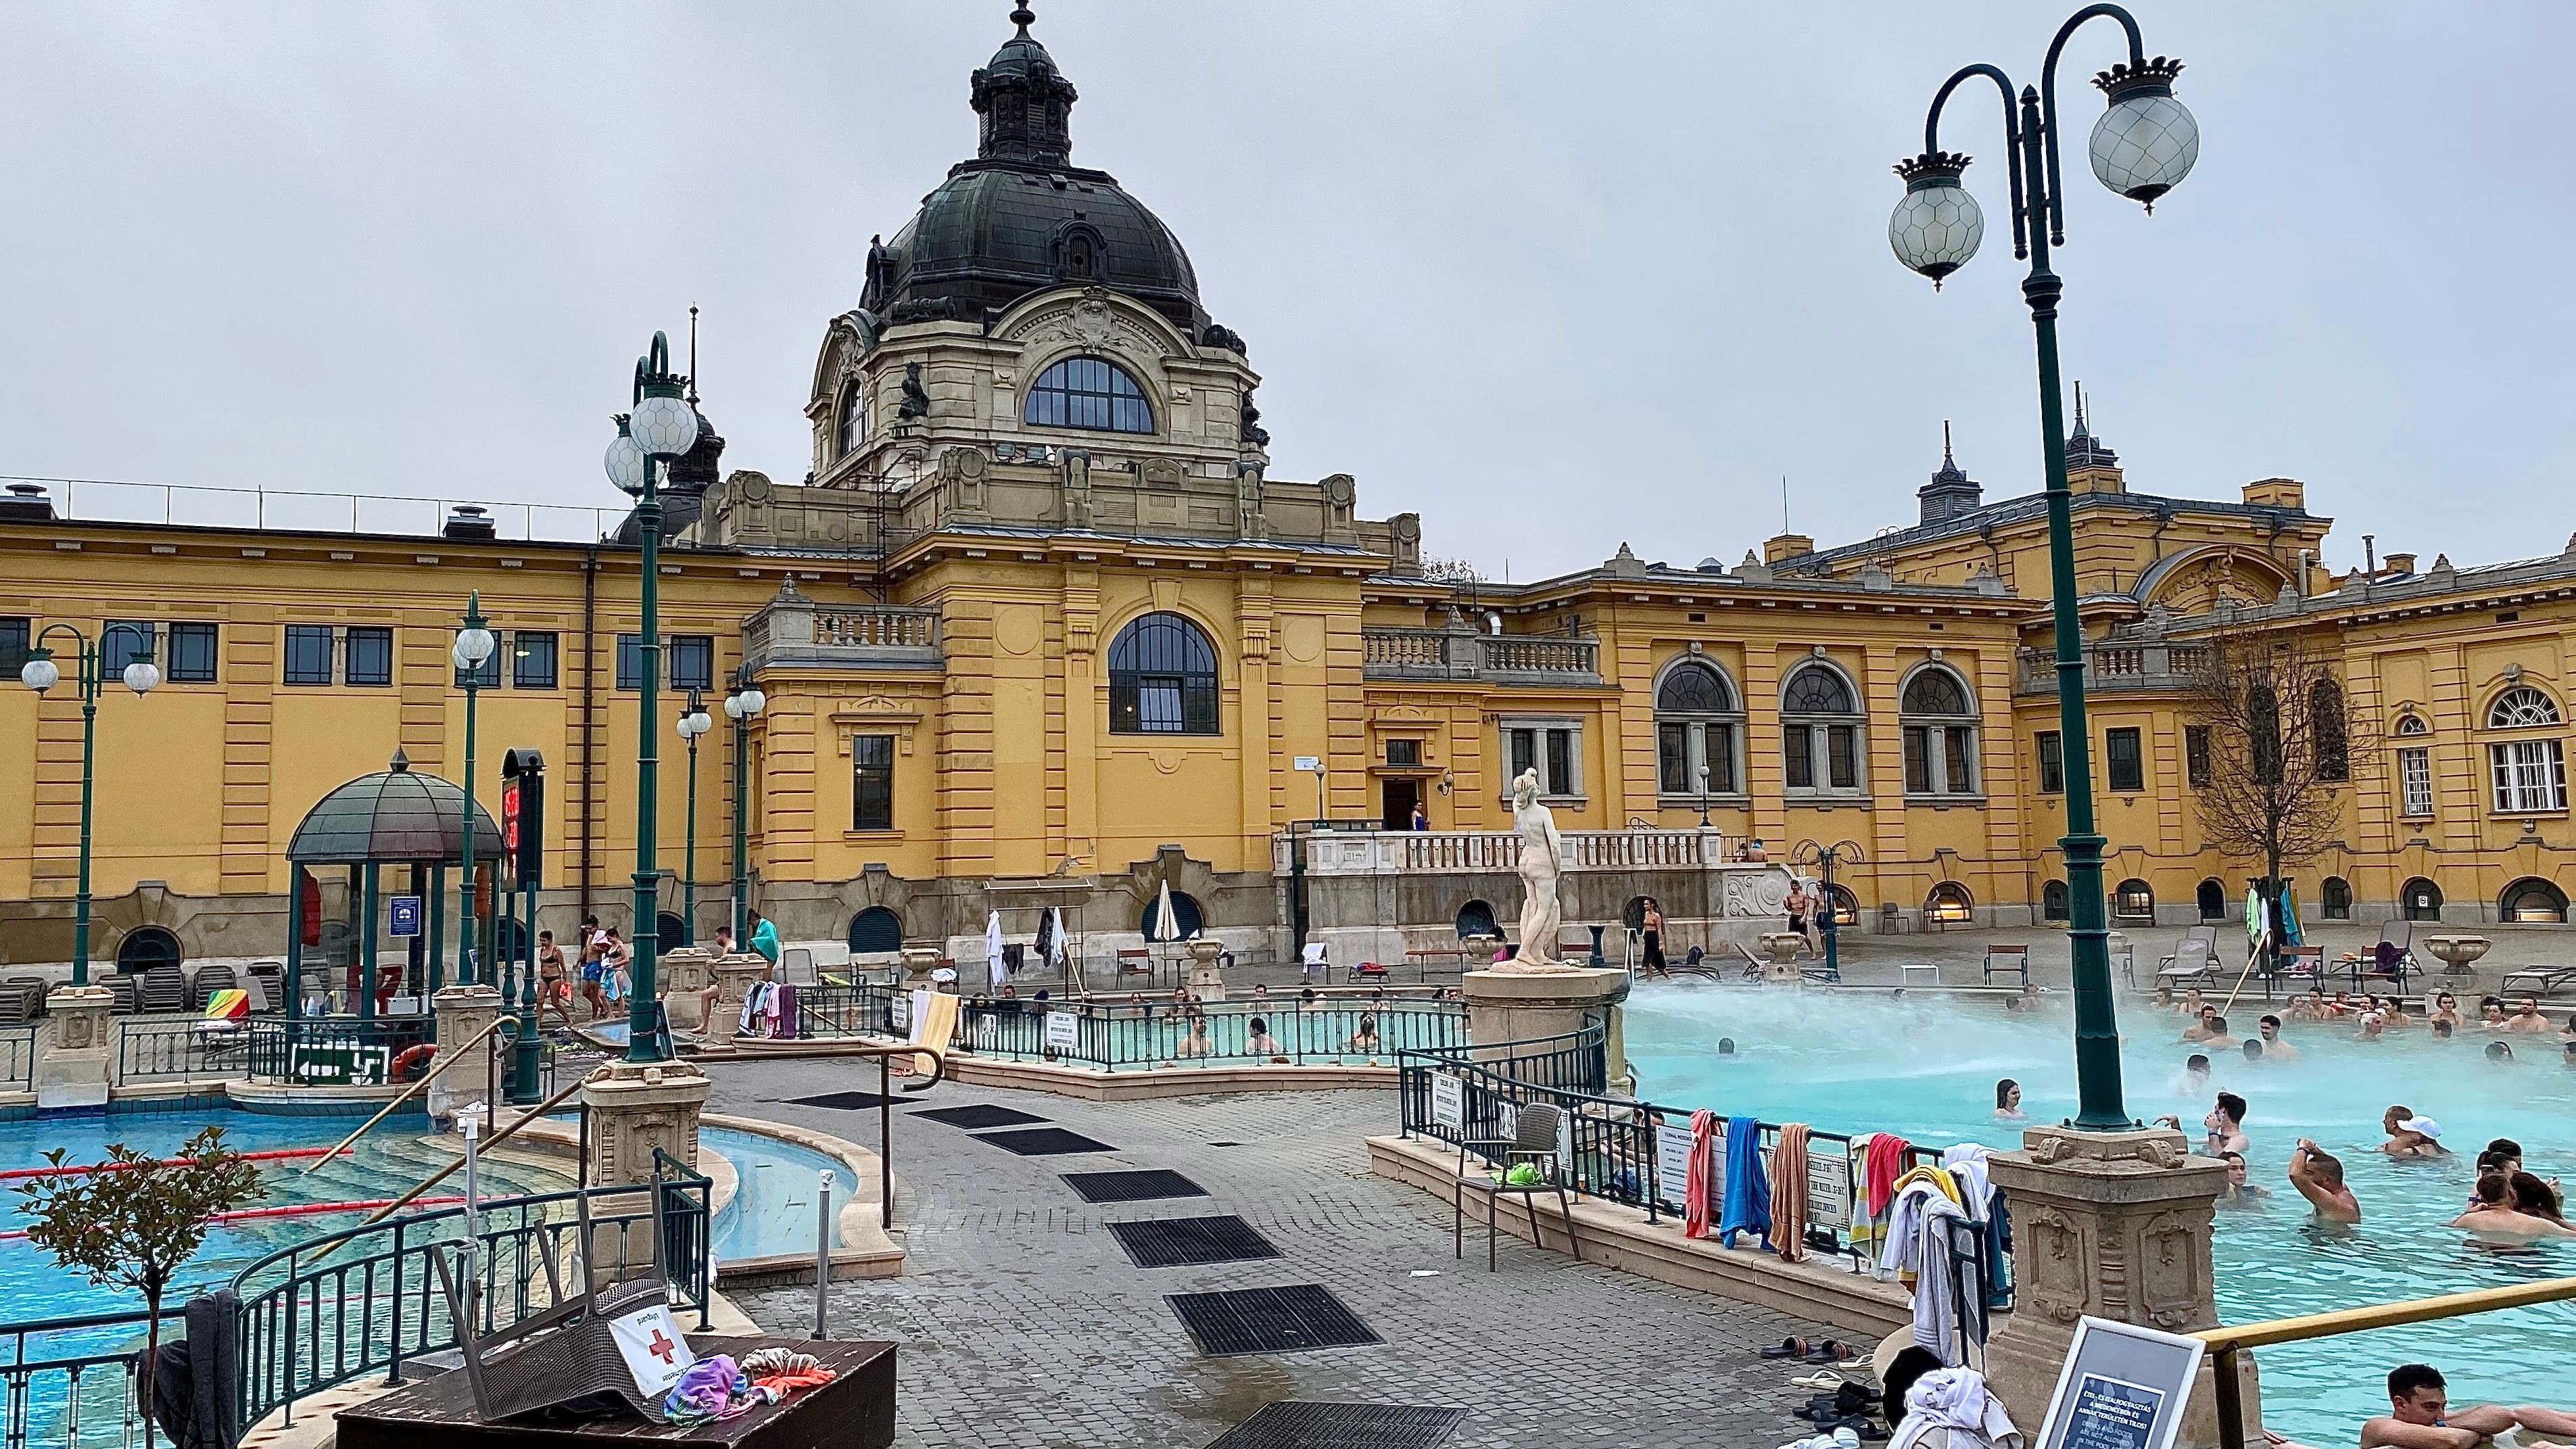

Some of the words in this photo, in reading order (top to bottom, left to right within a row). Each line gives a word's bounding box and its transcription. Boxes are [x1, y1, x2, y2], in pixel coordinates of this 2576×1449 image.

[637, 1312, 659, 1326] Lifeguard
[2132, 1410, 2140, 1419] ÉS
[2101, 1425, 2114, 1433] AND
[2129, 1419, 2147, 1430] TILOS!
[2091, 1431, 2103, 1439] NOT
[2103, 1435, 2130, 1446] ALLOWED
